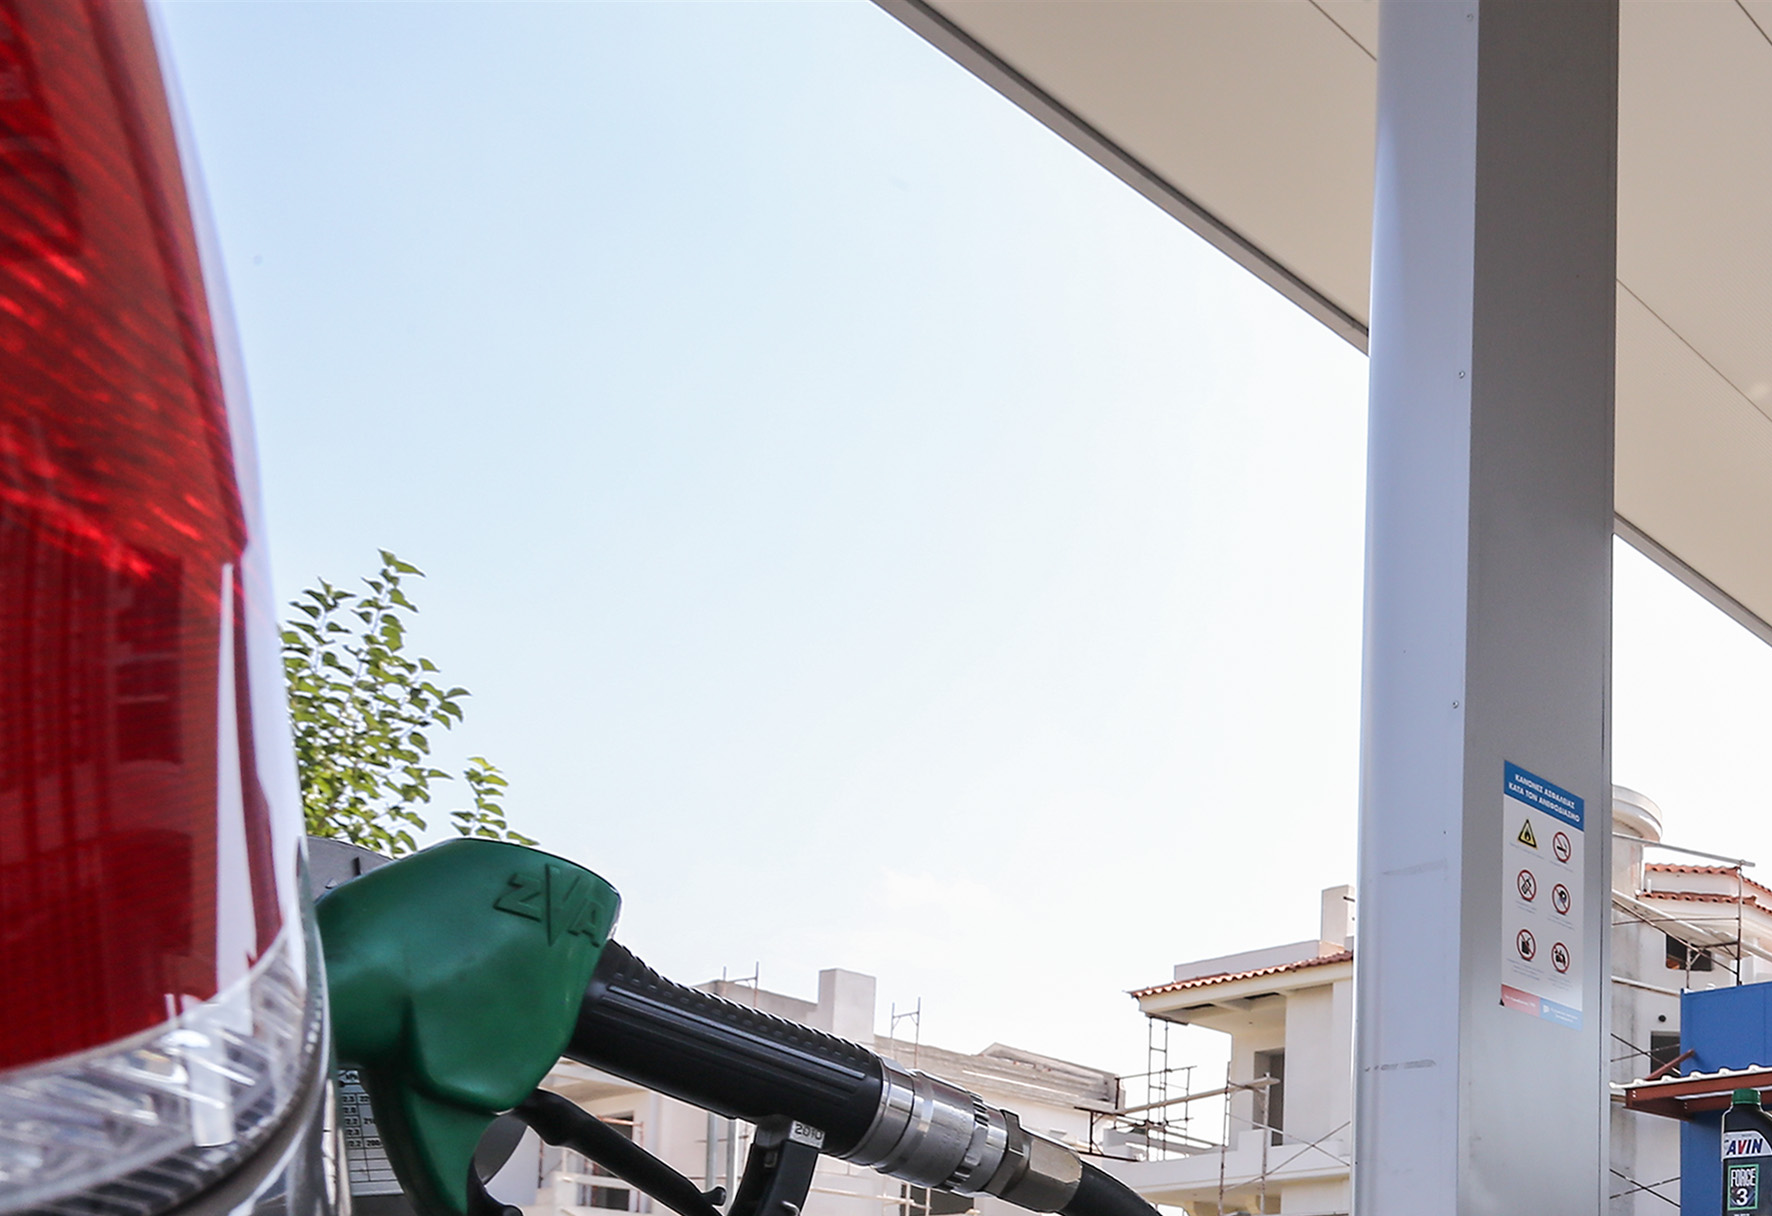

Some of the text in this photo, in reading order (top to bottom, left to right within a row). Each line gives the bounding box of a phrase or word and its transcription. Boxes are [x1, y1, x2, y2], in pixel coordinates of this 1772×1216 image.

[794, 1123, 823, 1141] 2010
[1726, 1138, 1763, 1156] AVIN
[1730, 1168, 1756, 1188] FORCE
[1737, 1188, 1749, 1206] 3
